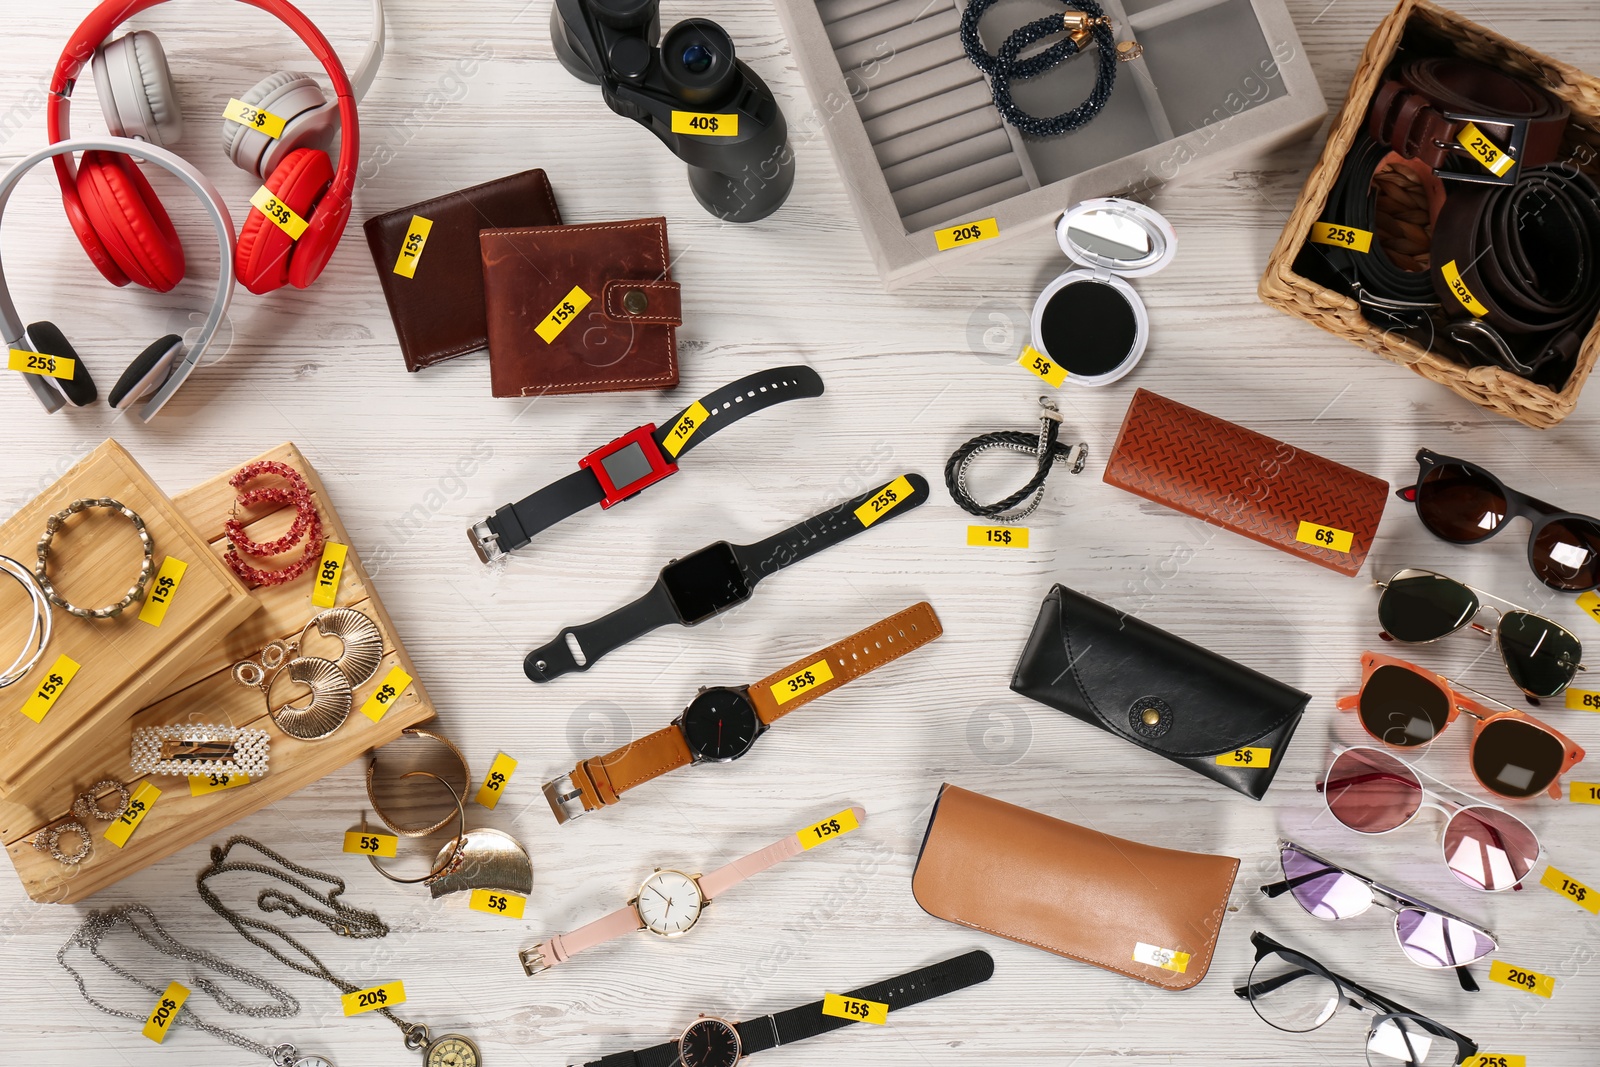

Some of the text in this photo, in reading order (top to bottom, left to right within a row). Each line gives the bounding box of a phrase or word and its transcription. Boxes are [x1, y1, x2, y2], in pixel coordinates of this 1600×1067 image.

[240, 107, 267, 127] 23$
[690, 117, 718, 132] 40$
[1471, 138, 1497, 162] 25$
[266, 200, 290, 223] 33$
[953, 226, 981, 241] 20$
[1327, 228, 1355, 245] 25$
[404, 234, 422, 257] 15$
[1453, 280, 1471, 303] 30$
[552, 302, 574, 324] 15$
[28, 356, 55, 373] 25$
[1033, 358, 1050, 375] 5$
[675, 417, 693, 438] 15$
[872, 490, 896, 512] 25$
[987, 530, 1011, 544] 15$
[1316, 529, 1334, 544] 6$
[321, 561, 339, 585] 18$
[152, 577, 174, 603] 15$
[38, 674, 63, 699] 15$
[788, 672, 815, 691] 35$
[376, 685, 395, 703] 8$
[1233, 749, 1253, 765] 5$
[209, 773, 229, 786] 3$
[487, 772, 505, 790] 5$
[120, 797, 146, 826] 15$
[814, 820, 840, 837] 15$
[361, 837, 379, 852] 5$
[1563, 880, 1586, 901] 15$
[489, 896, 506, 912] 5$
[1508, 970, 1535, 989] 20$
[359, 989, 387, 1006] 20$
[153, 1000, 176, 1027] 20$
[844, 1001, 869, 1018] 15$
